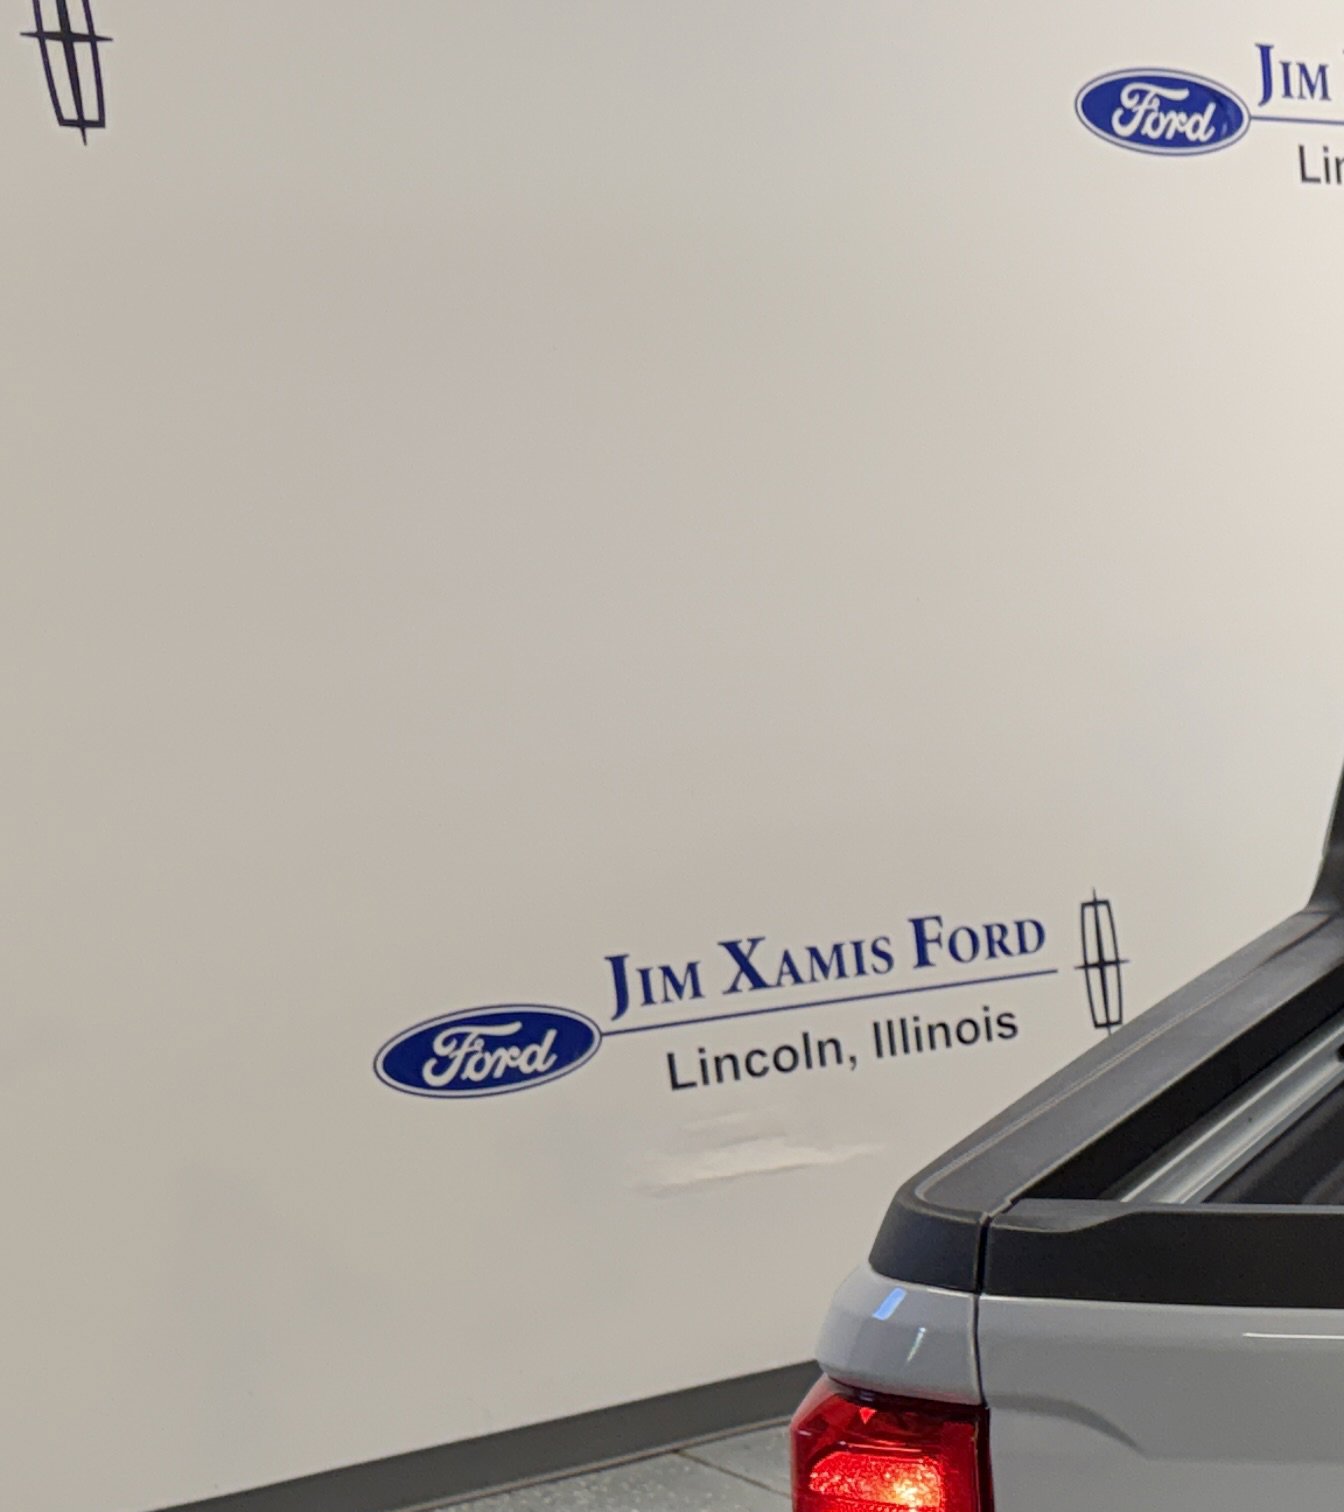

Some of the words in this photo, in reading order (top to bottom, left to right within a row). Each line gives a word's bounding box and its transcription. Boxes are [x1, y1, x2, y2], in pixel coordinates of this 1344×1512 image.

[1254, 43, 1332, 106] JIM
[1111, 81, 1217, 143] Ford
[605, 954, 705, 1022] JIM
[716, 935, 894, 998] XAMIS
[908, 915, 1046, 970] FORD
[421, 1022, 559, 1088] Ford
[666, 1029, 858, 1091] Lincoln,
[872, 1006, 1019, 1059] Illinois
